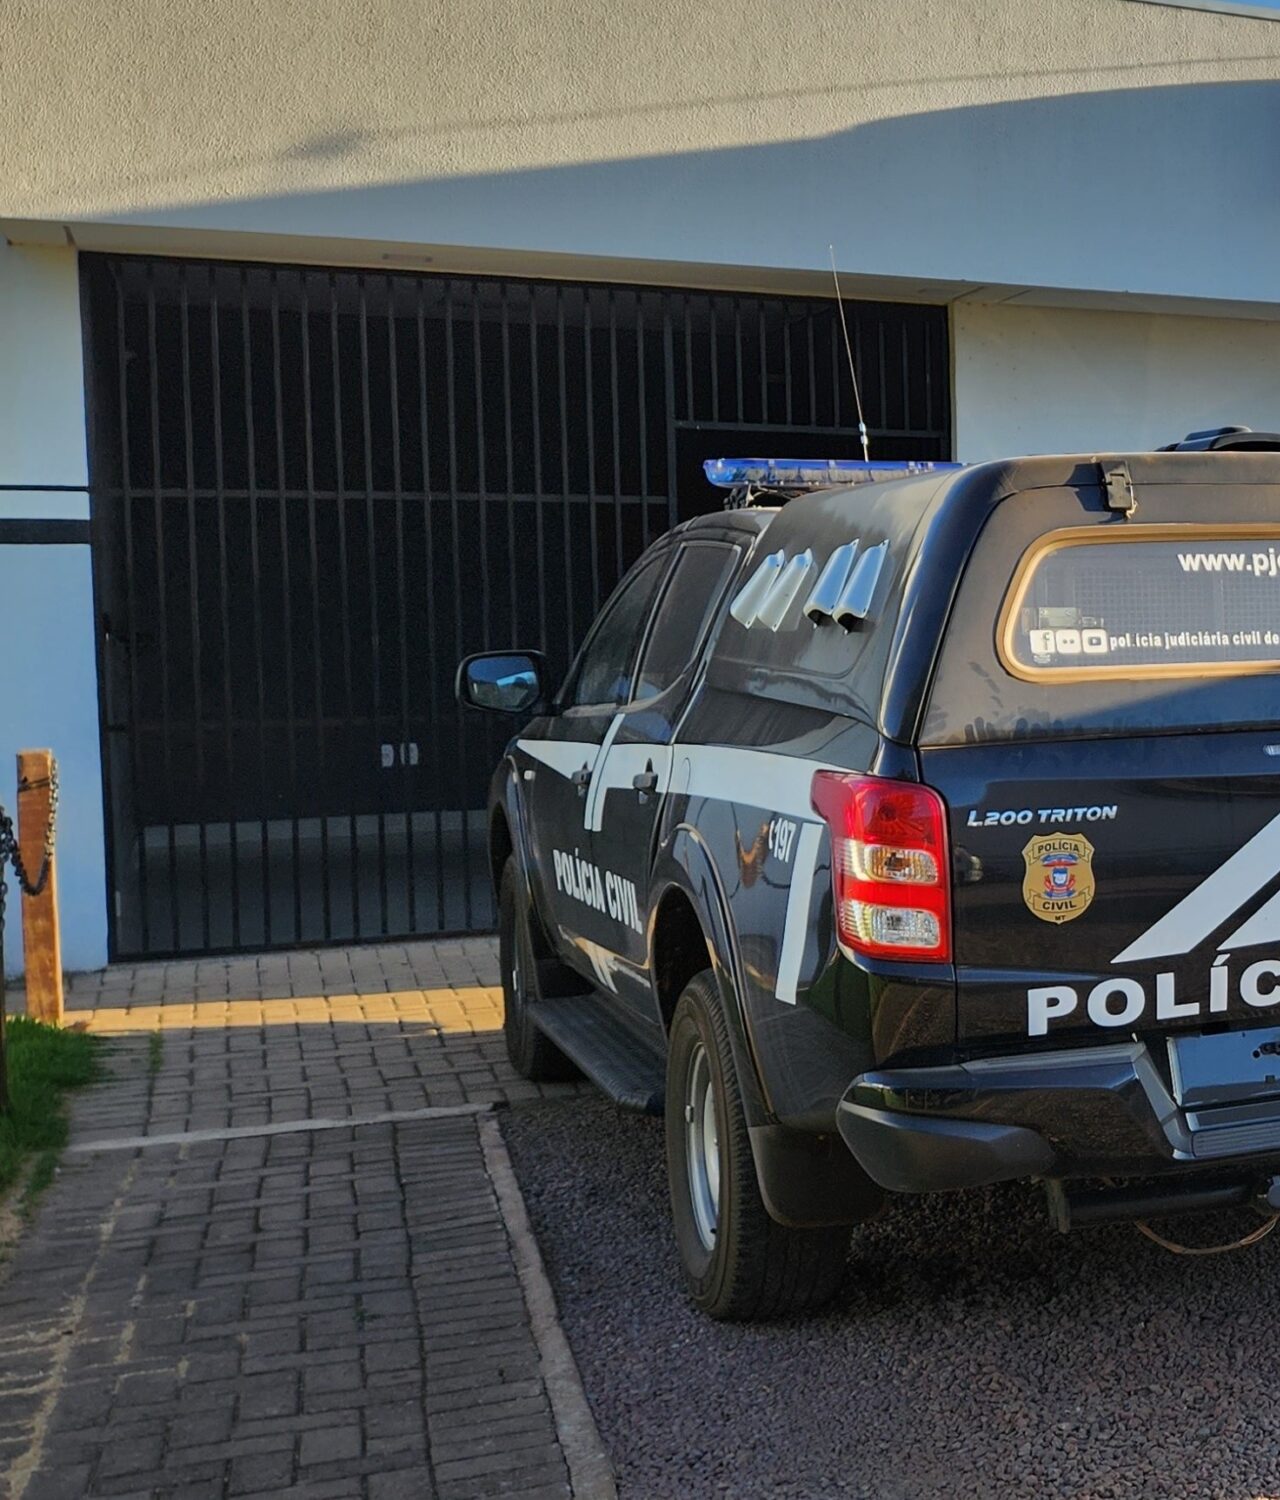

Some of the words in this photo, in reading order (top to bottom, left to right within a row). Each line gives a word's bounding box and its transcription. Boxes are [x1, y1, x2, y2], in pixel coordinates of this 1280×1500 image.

[1232, 631, 1261, 645] civil
[1263, 631, 1280, 645] de
[967, 809, 1033, 827] L200
[1037, 805, 1118, 824] TRITON
[774, 817, 797, 863] 197
[1037, 841, 1080, 853] POLÍCIA
[553, 847, 606, 913] POLÍCIA
[605, 870, 643, 934] CIVIL
[1042, 901, 1077, 911] CIVIL
